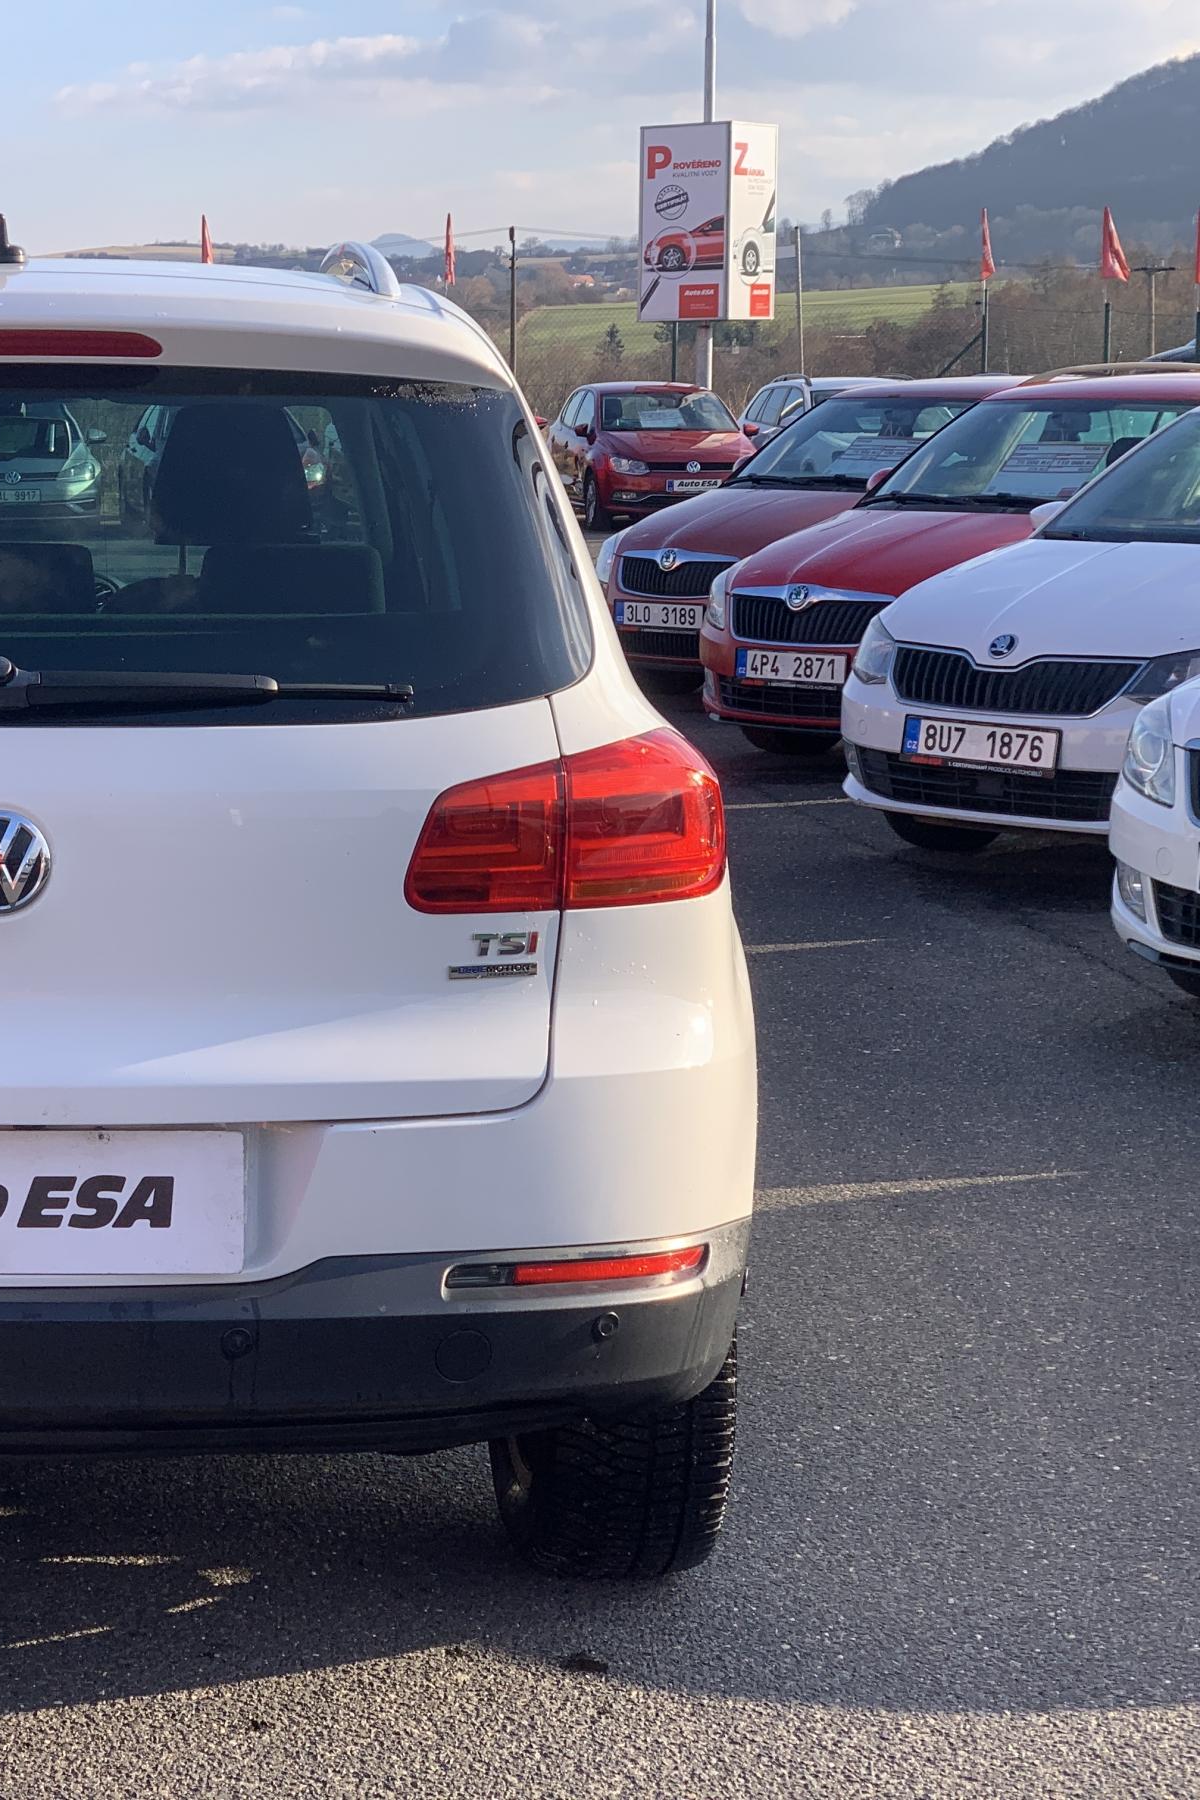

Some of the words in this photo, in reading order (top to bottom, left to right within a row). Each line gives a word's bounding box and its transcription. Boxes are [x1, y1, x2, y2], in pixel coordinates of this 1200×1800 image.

[677, 480, 700, 488] Auto
[661, 606, 696, 626] 3189
[750, 653, 780, 677] 4P4
[792, 656, 836, 680] 2871
[906, 739, 918, 749] CZ
[924, 723, 967, 754] 8U7
[986, 730, 1044, 763] 1876
[473, 931, 539, 957] TSI
[16, 1174, 175, 1230] ESA
